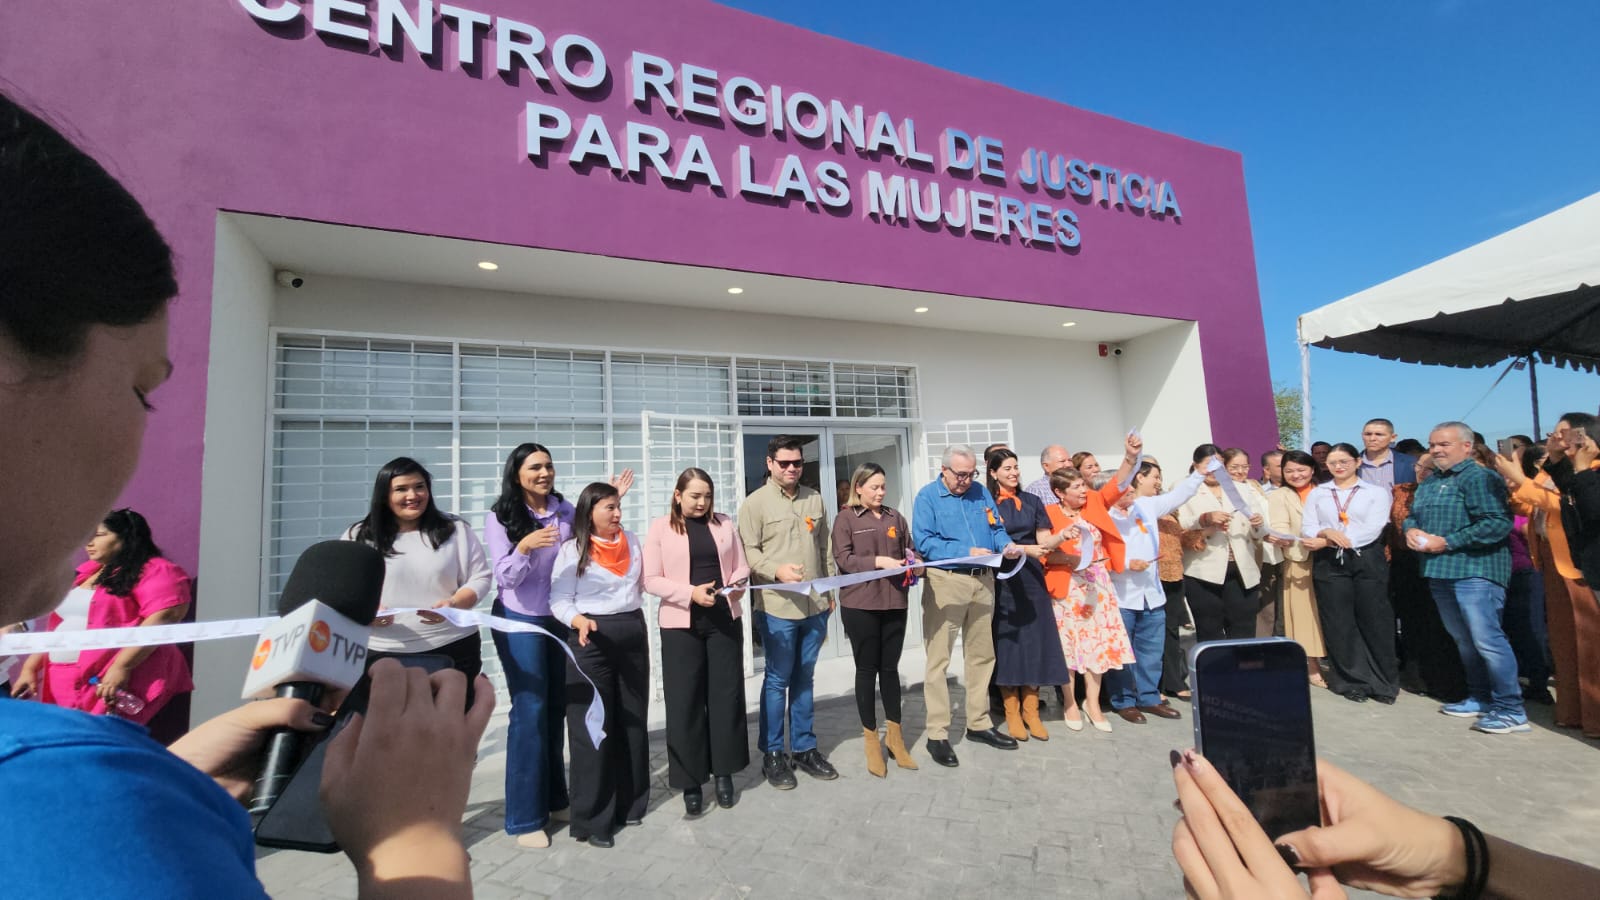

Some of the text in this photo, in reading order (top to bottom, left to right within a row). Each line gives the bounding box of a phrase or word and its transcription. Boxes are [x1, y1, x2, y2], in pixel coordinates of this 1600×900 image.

[526, 102, 1082, 248] PARA LAS MUJERES
[632, 51, 934, 165] REGIONAL
[948, 127, 1006, 178] DE
[1020, 147, 1183, 218] JUSTICIA
[271, 623, 305, 660] TVP
[332, 633, 366, 665] TVP
